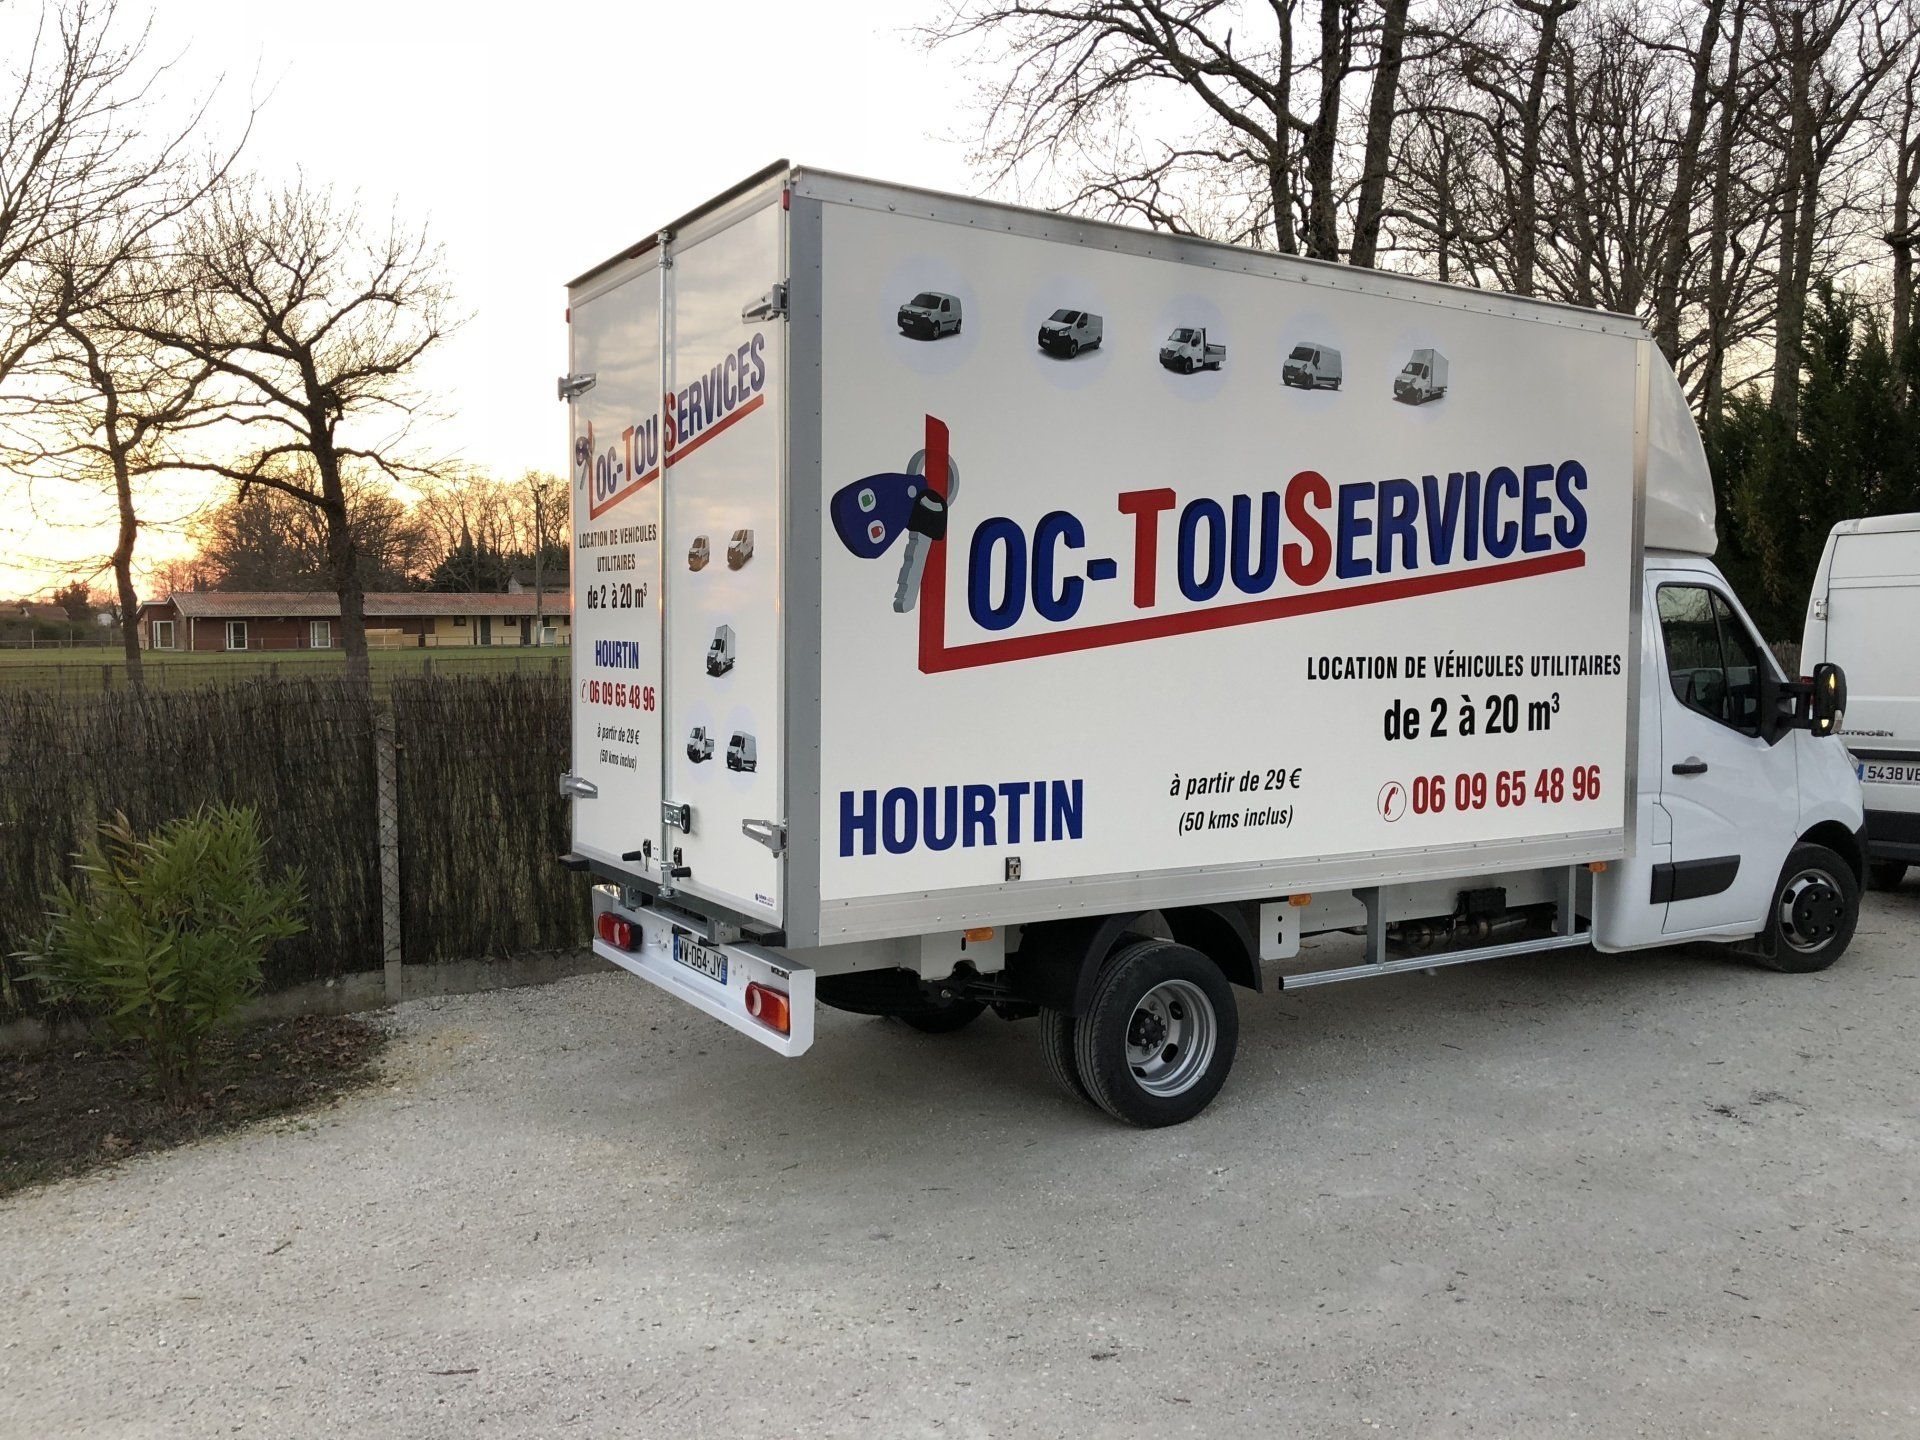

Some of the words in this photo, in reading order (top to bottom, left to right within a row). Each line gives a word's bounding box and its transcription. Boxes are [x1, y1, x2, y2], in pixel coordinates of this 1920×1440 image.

[579, 530, 608, 549] LOCATION
[610, 529, 618, 545] DE
[620, 524, 657, 544] VEHICULES
[597, 553, 636, 572] UTILITAIRES
[587, 585, 598, 609] de
[600, 584, 606, 608] 2
[611, 583, 617, 609] à
[620, 583, 632, 608] 20
[595, 640, 639, 669] HOURTIN
[1307, 656, 1397, 681] LOCATION
[1405, 656, 1427, 679] DE
[1434, 650, 1524, 678] VÉHICULES
[1530, 654, 1622, 677] UTILITAIRES
[589, 680, 600, 704] 06
[602, 682, 613, 705] 09
[615, 683, 626, 707] 65
[628, 684, 640, 709] 48
[643, 686, 655, 712] 96
[1384, 699, 1420, 741] de
[1430, 697, 1448, 738] 2
[1458, 694, 1476, 736] à
[1485, 693, 1519, 734] 20
[601, 725, 618, 742] partir
[618, 726, 625, 742] de
[1836, 729, 1894, 737] CITROËN
[600, 749, 608, 764] (50
[608, 750, 619, 765] kms
[619, 752, 637, 773] inclus)
[1867, 765, 1904, 781] 5438
[1169, 773, 1181, 797] à
[1185, 771, 1235, 801] partir
[1239, 770, 1261, 793] de
[1265, 769, 1287, 792] 29
[1412, 775, 1446, 815] 06
[1455, 772, 1487, 811] 09
[1496, 769, 1526, 807] 65
[1534, 767, 1564, 803] 48
[1572, 764, 1601, 801] 96
[839, 779, 1084, 857] HOURTIN
[1178, 809, 1203, 837] (50
[1208, 807, 1239, 831] kms
[1243, 804, 1294, 831] inclus)
